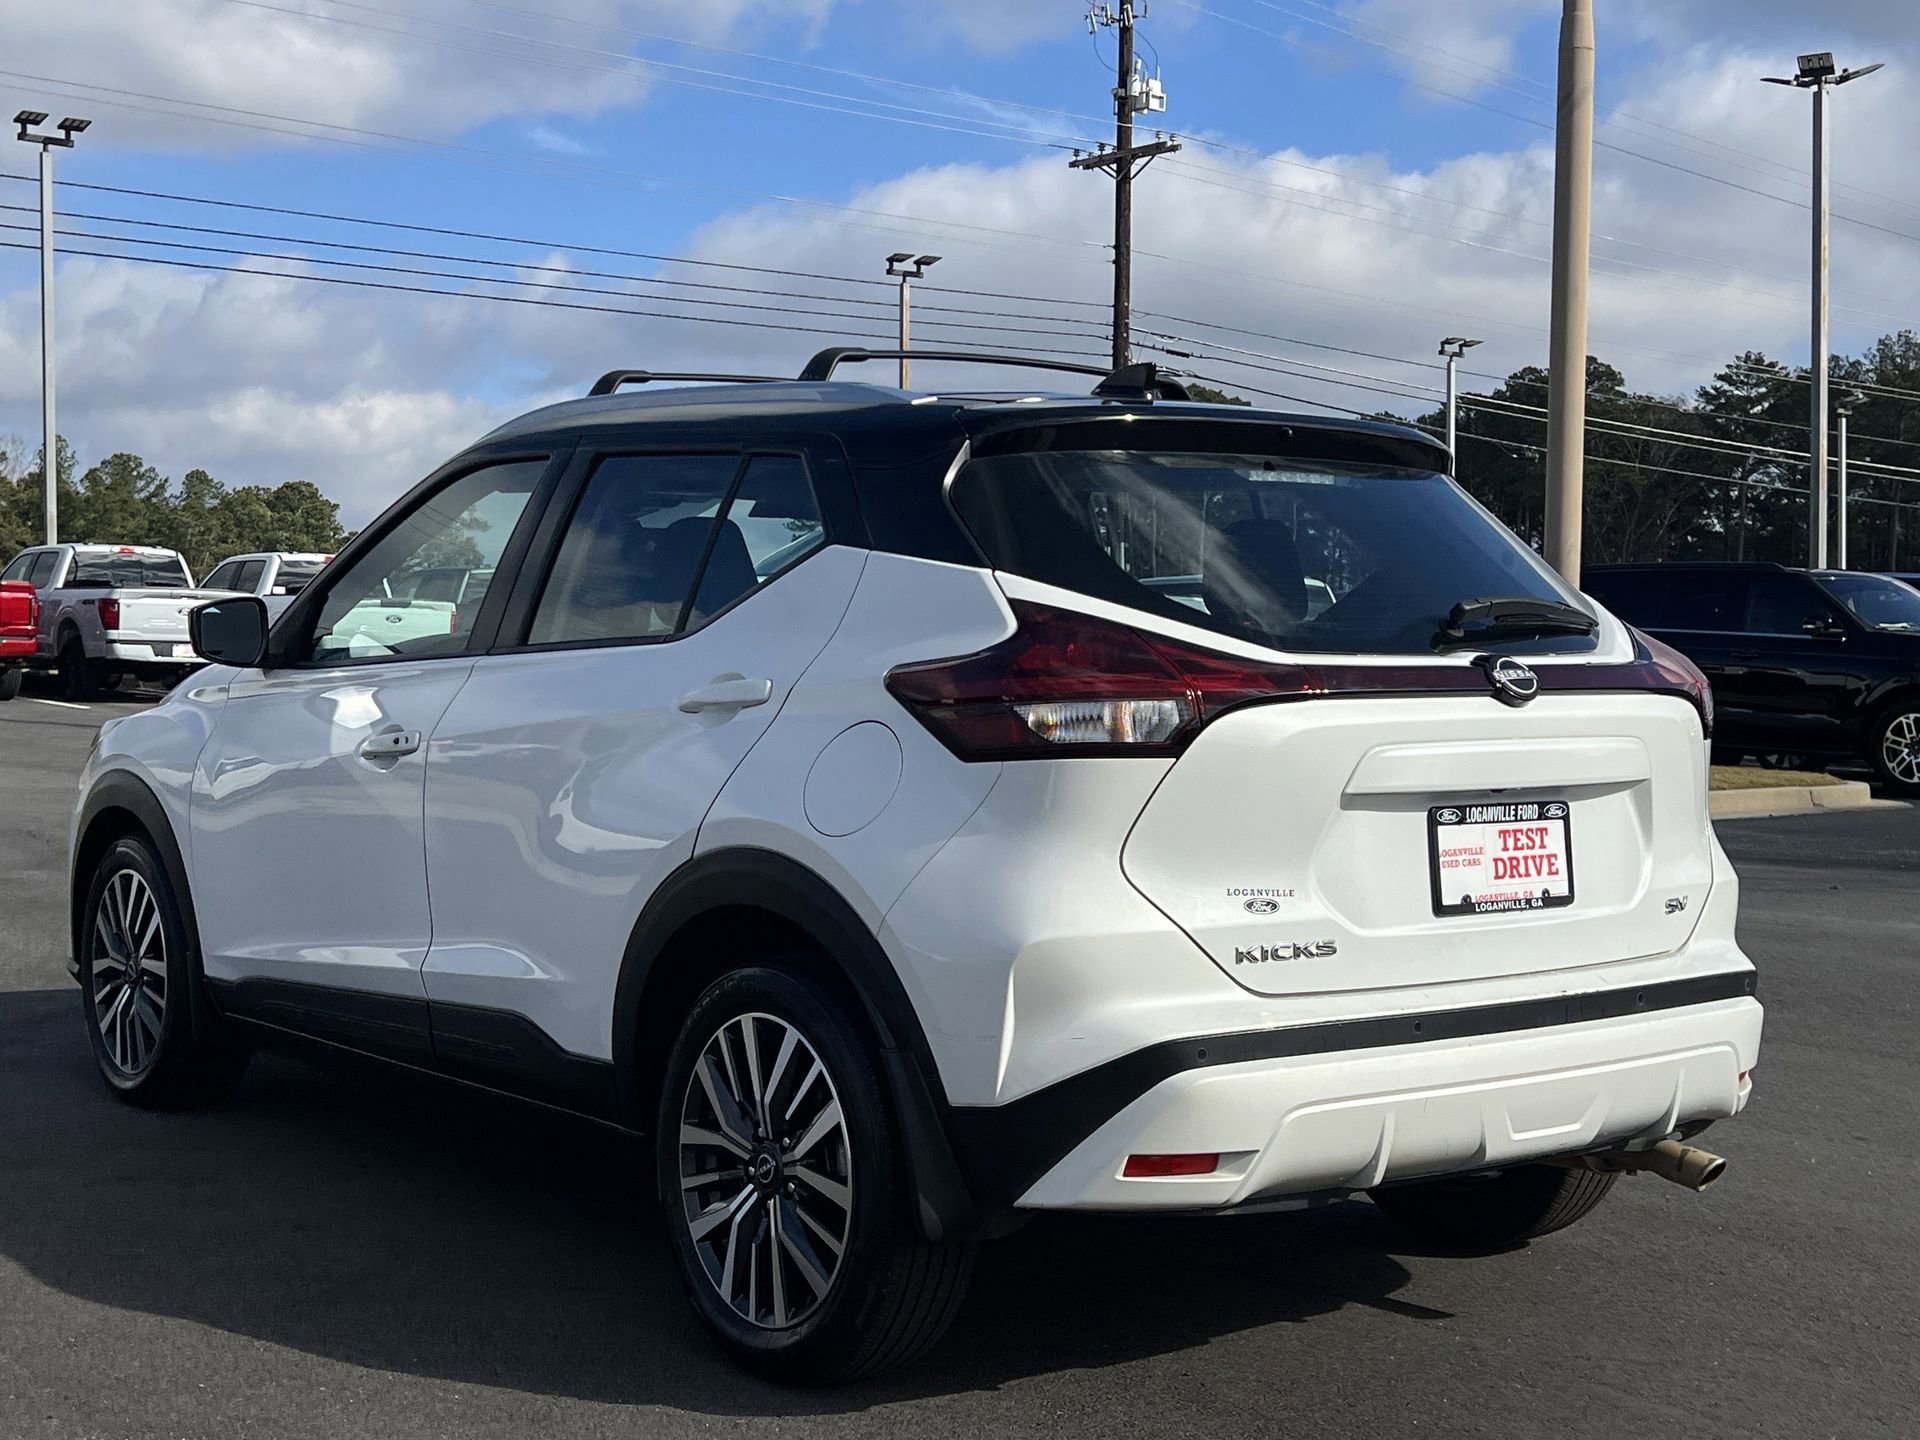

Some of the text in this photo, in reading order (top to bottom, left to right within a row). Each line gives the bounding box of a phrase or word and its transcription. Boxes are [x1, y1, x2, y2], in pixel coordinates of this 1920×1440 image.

[1466, 804, 1538, 822] LOGANVILLE FORD
[1498, 827, 1548, 852] TEST
[1440, 847, 1484, 857] OGANVILLE
[1442, 858, 1481, 868] USED CARS
[1493, 853, 1559, 880] DRIVE
[1227, 888, 1295, 897] LOGANVILLE
[1523, 891, 1533, 899] GA
[1475, 898, 1543, 912] LOGANVILLE, GA
[1665, 895, 1688, 915] SV
[1235, 939, 1337, 965] KICKS
